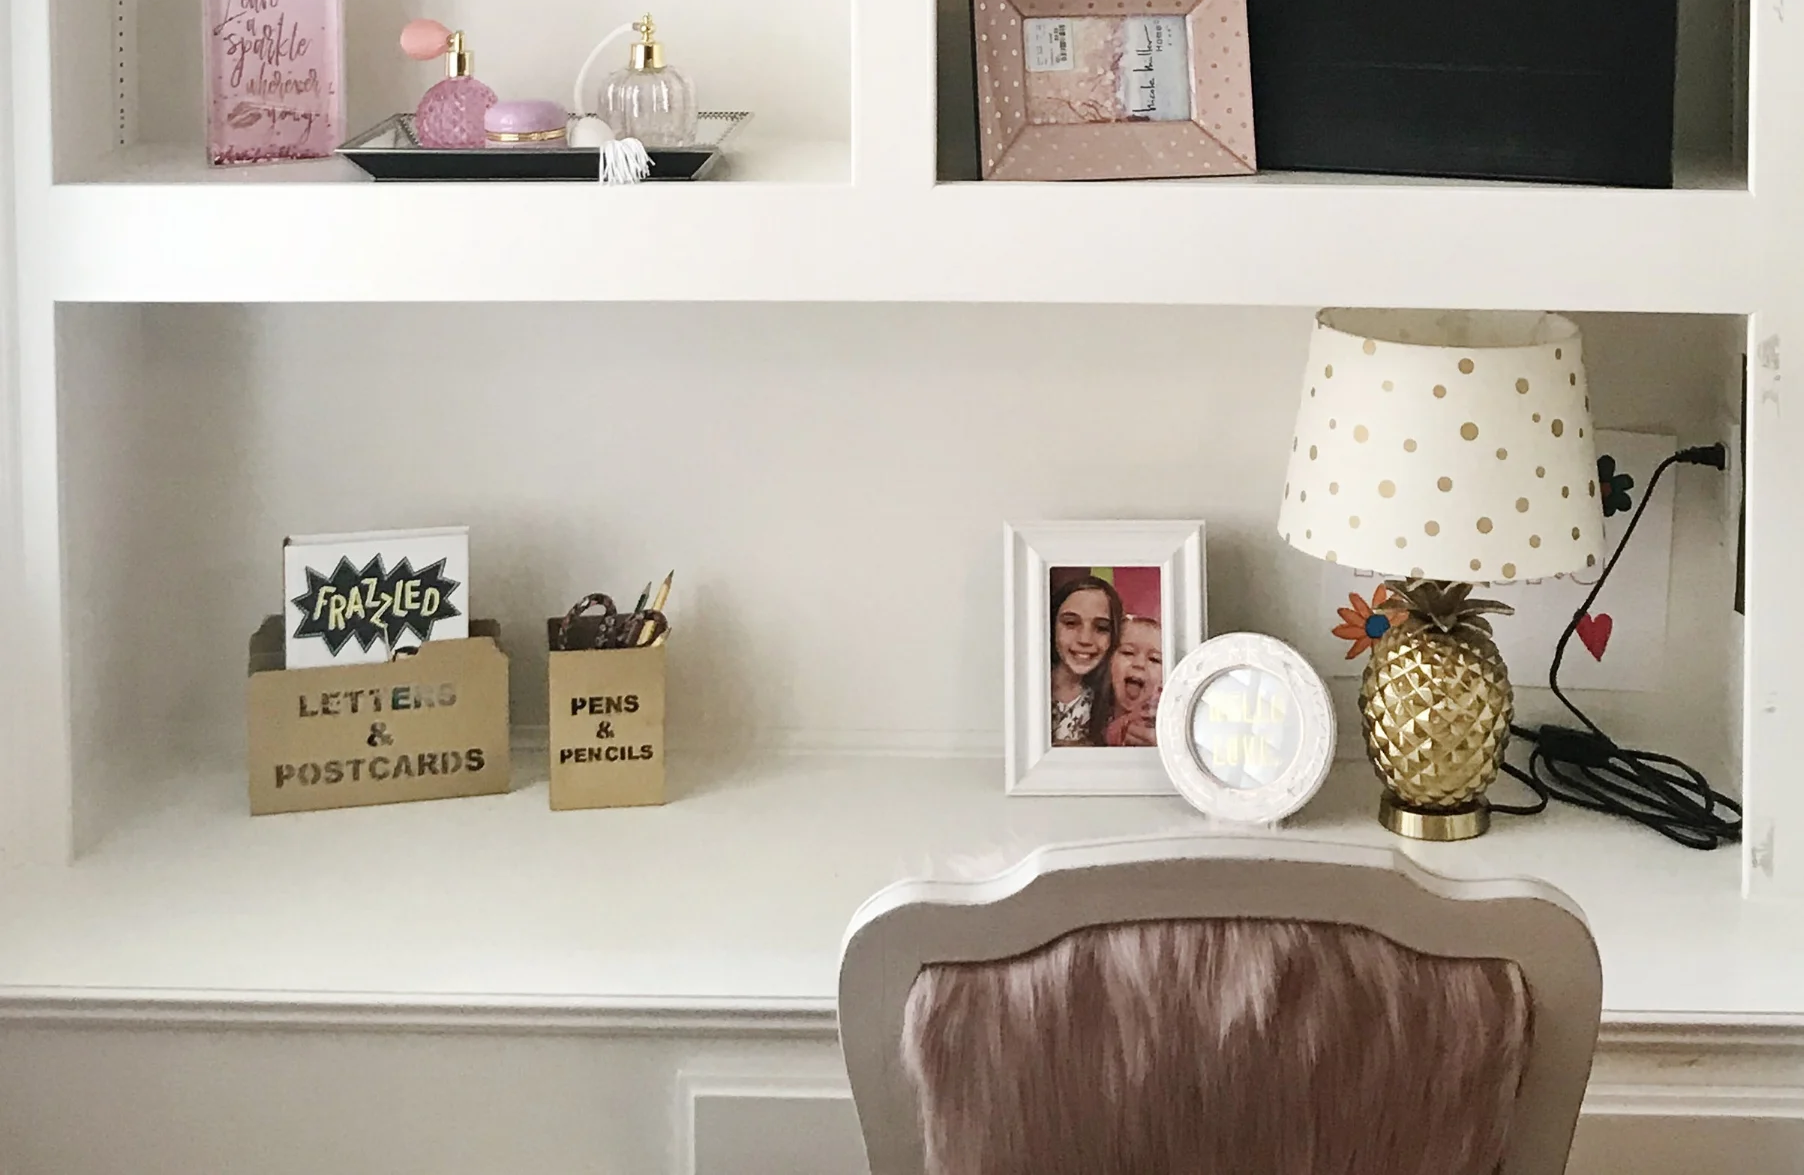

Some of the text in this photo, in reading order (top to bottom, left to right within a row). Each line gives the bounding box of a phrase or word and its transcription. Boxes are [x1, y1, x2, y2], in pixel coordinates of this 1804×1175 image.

[312, 577, 441, 631] FRAZZLED
[299, 682, 458, 718] LETTERS
[571, 694, 640, 716] PENS
[366, 721, 395, 748] &
[596, 720, 616, 739] &
[559, 743, 655, 765] PENCILS
[275, 748, 486, 789] POSTCARDS
